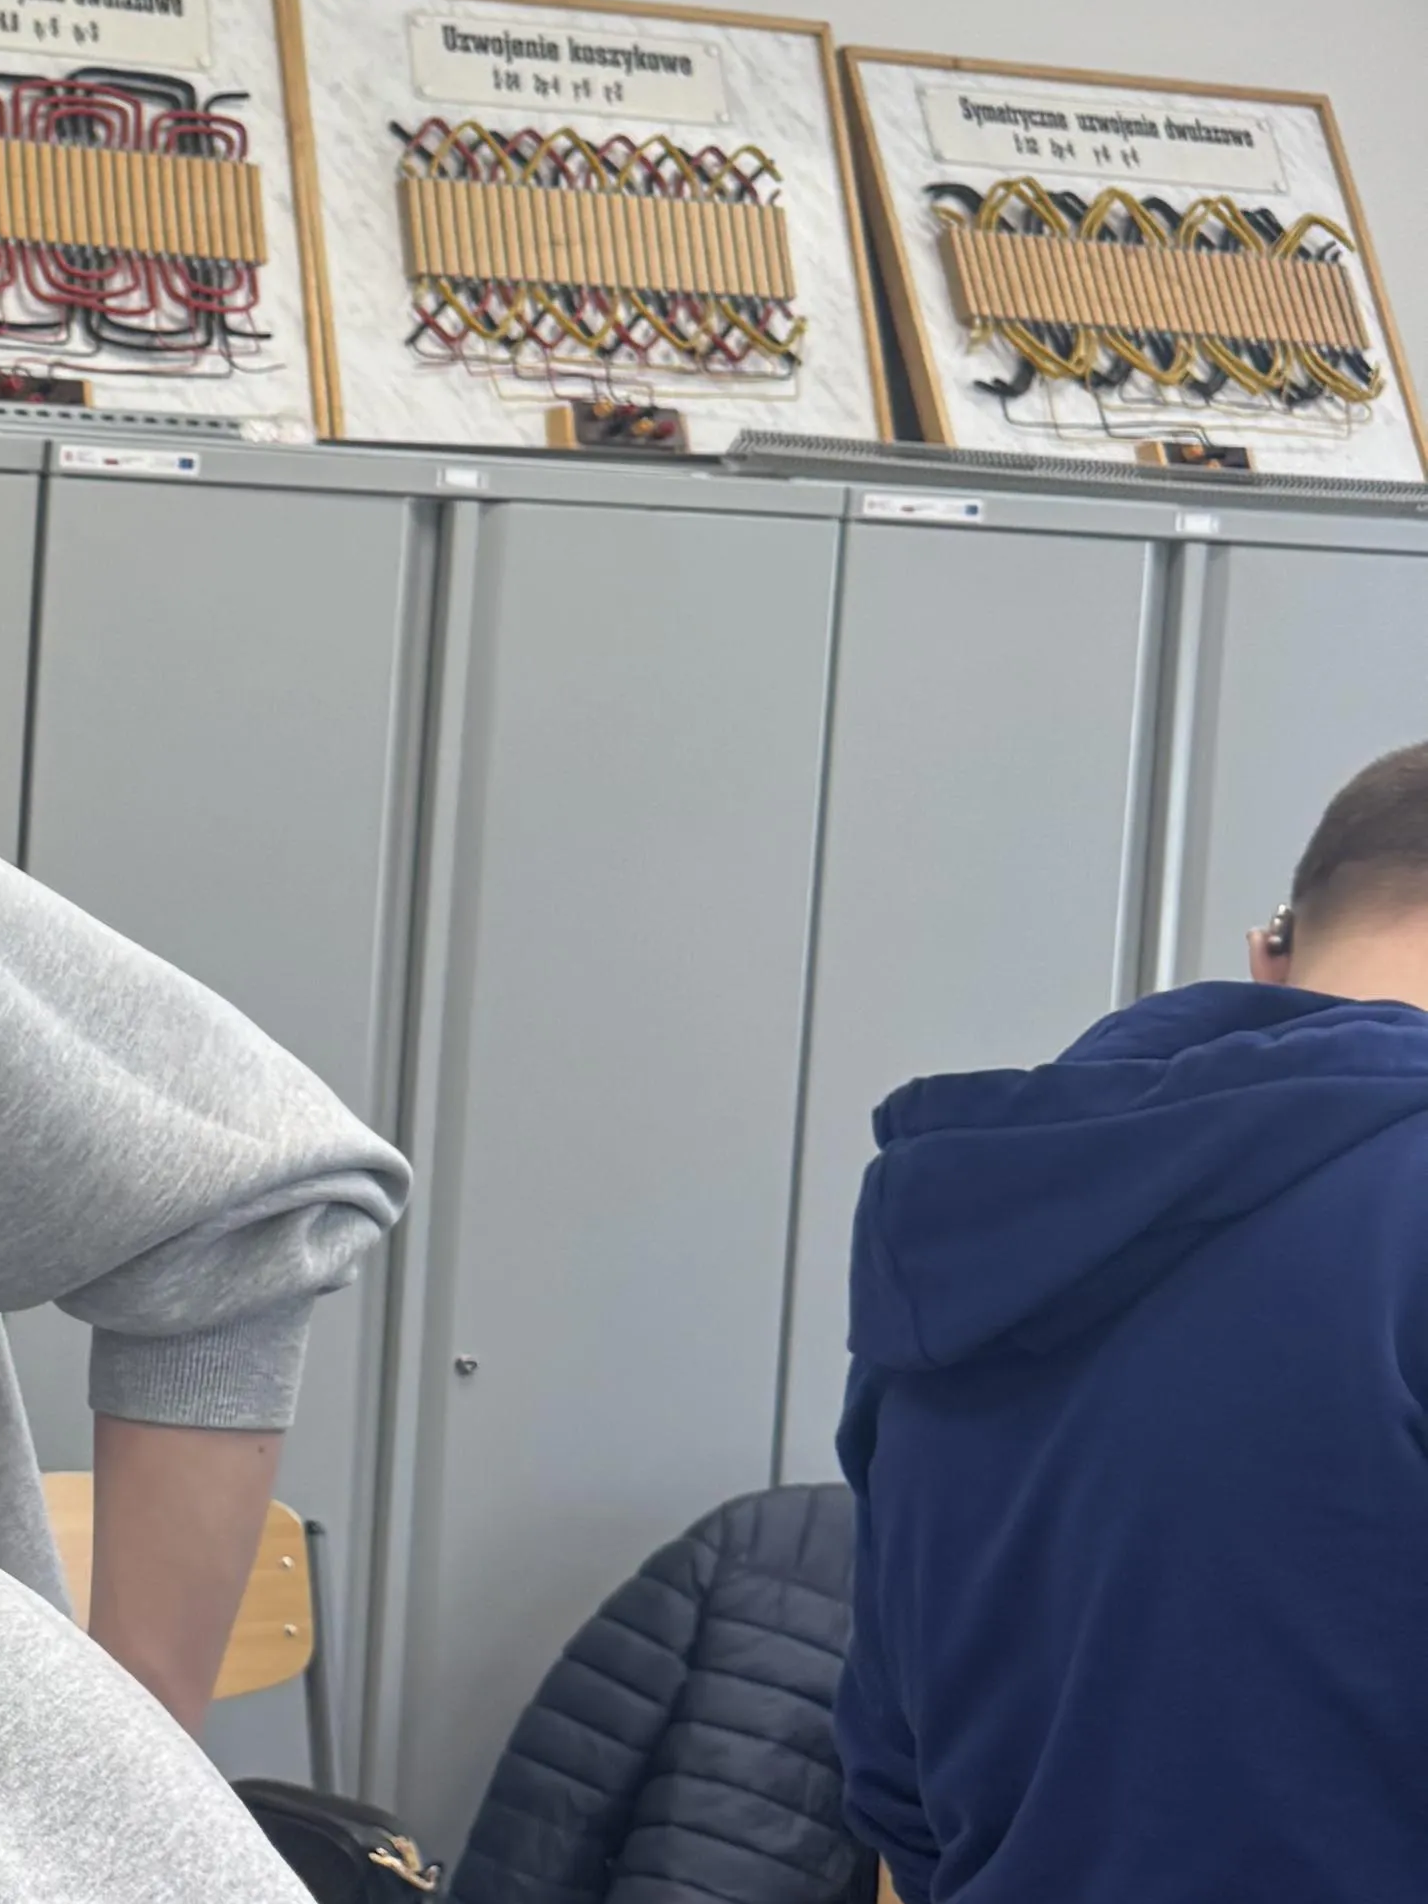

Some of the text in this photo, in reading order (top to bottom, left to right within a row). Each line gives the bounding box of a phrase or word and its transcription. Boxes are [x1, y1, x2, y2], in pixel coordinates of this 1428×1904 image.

[441, 24, 693, 77] Uzwojenie koszykowe
[958, 94, 1254, 149] Symetryczne uzwojenie dwufazowe
